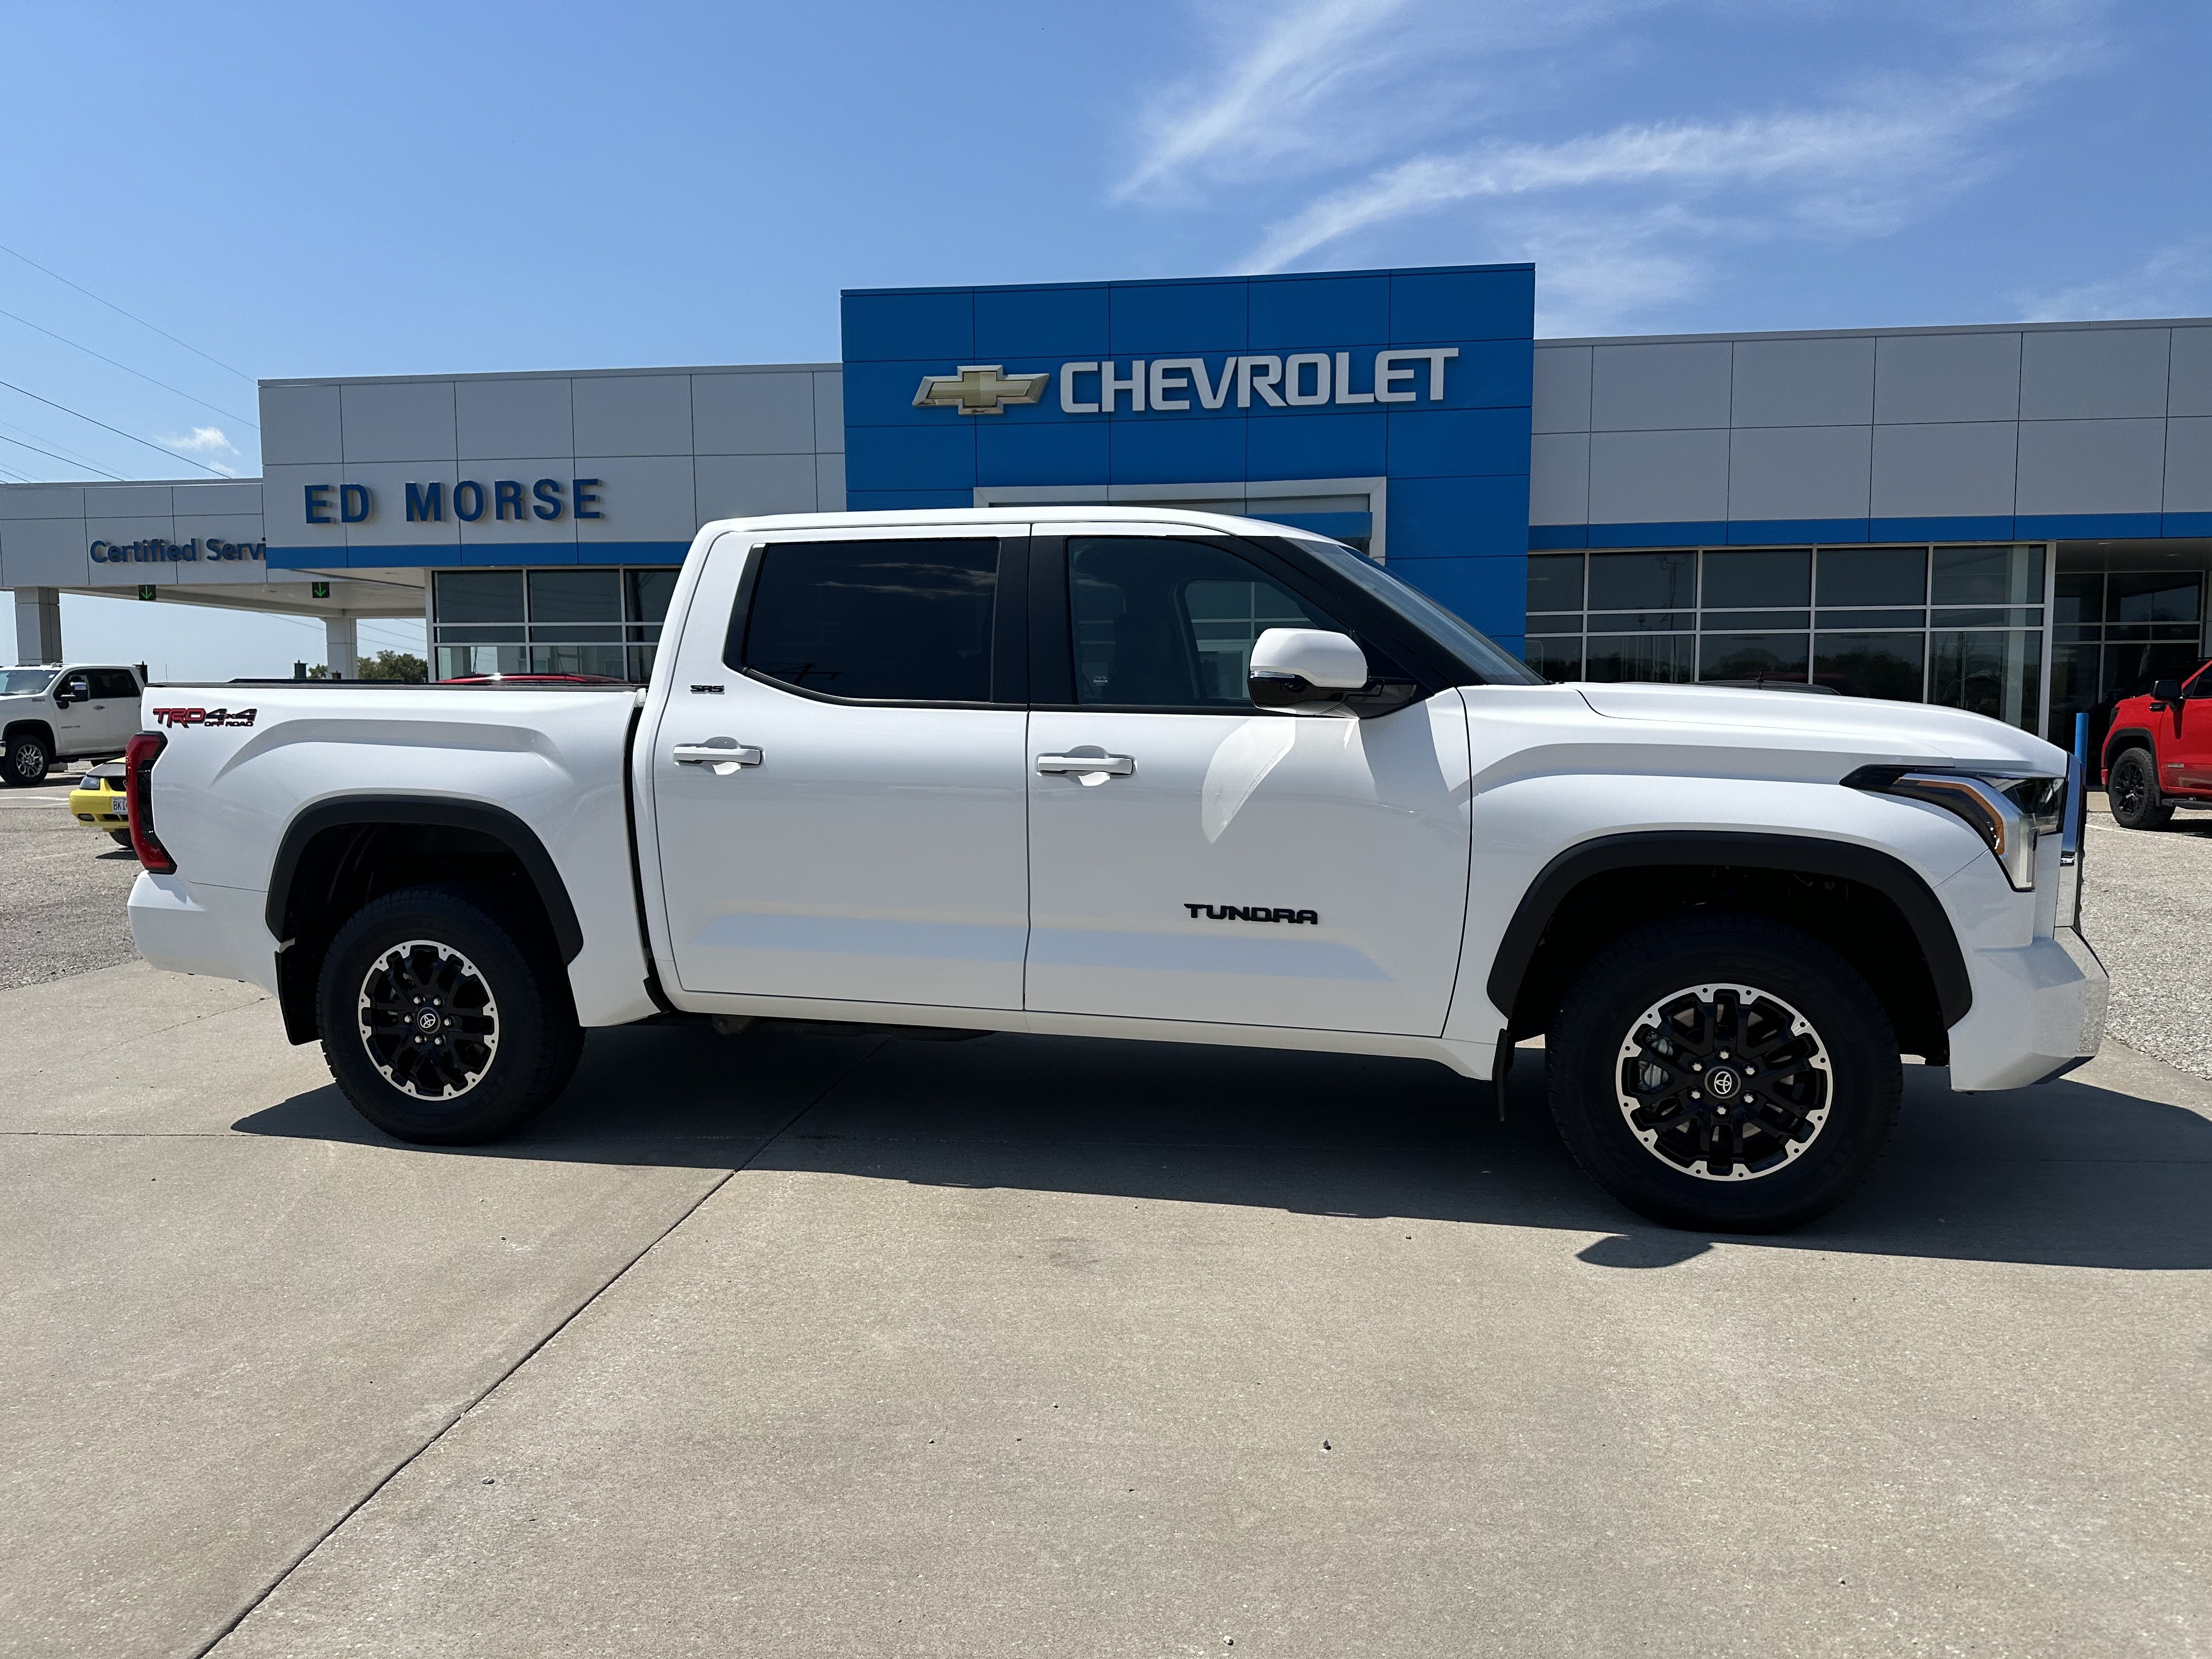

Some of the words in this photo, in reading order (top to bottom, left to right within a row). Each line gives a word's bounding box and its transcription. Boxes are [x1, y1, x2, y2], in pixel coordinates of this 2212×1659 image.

[1060, 348, 1459, 413] CHEVROLET
[304, 483, 371, 524] ED
[405, 478, 603, 522] MORSE
[90, 538, 196, 563] Certified
[206, 537, 266, 561] Servi
[153, 708, 206, 729] TRD
[1183, 903, 1318, 925] TUNDRA
